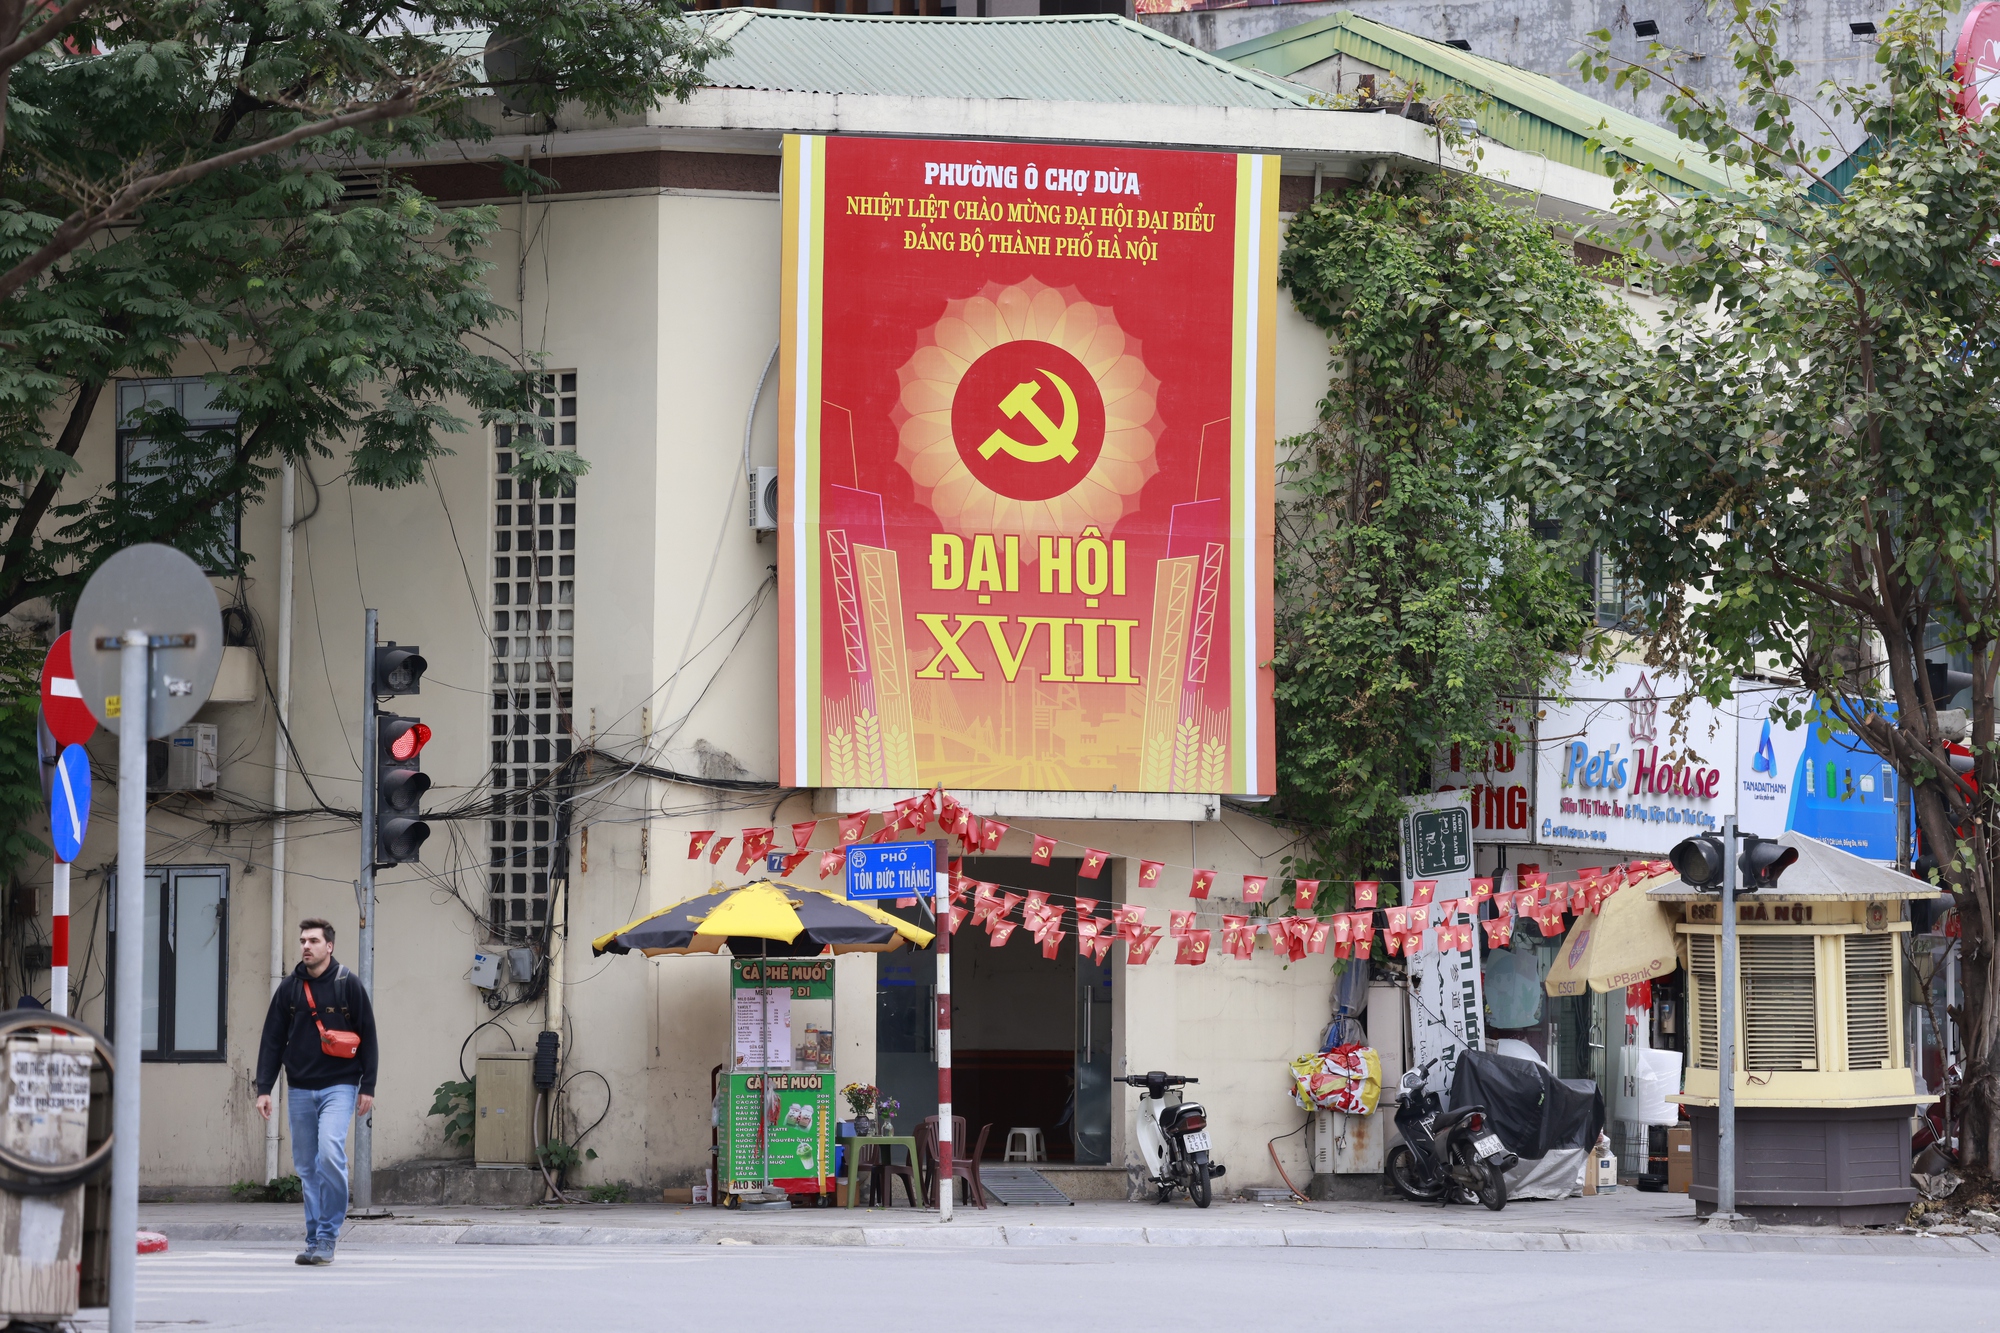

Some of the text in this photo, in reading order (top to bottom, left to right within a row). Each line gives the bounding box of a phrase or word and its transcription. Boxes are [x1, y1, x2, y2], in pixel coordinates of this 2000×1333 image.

[924, 160, 1140, 196] PHƯỜNG Ô CHỢ DỪA
[846, 191, 1215, 234] NHIỆT LIỆT CHÀO MỪNG ĐẠI HỘI ĐẠI BIỂU
[903, 223, 1158, 266] ĐẢNG BỘ THÀNH PHỐ HÀ NỘI
[928, 525, 1127, 608] ĐẠI HỘI
[915, 612, 1141, 685] XVIII
[1563, 741, 1720, 799] Pet's House
[1438, 783, 1517, 831] ƯNG
[880, 848, 908, 863] PHỐ
[854, 862, 930, 890] TÔN ĐỨC THẮNG
[1740, 902, 1769, 920] HÀ
[1775, 903, 1812, 924] NỘI
[742, 962, 826, 981] CÀ PHÊ MUỐI
[1607, 966, 1651, 989] LPBank
[797, 986, 810, 997] ĐI
[1558, 981, 1576, 994] CSGT
[746, 1073, 822, 1089] CÀ HÊ MUỐI
[733, 1181, 748, 1189] ALO
